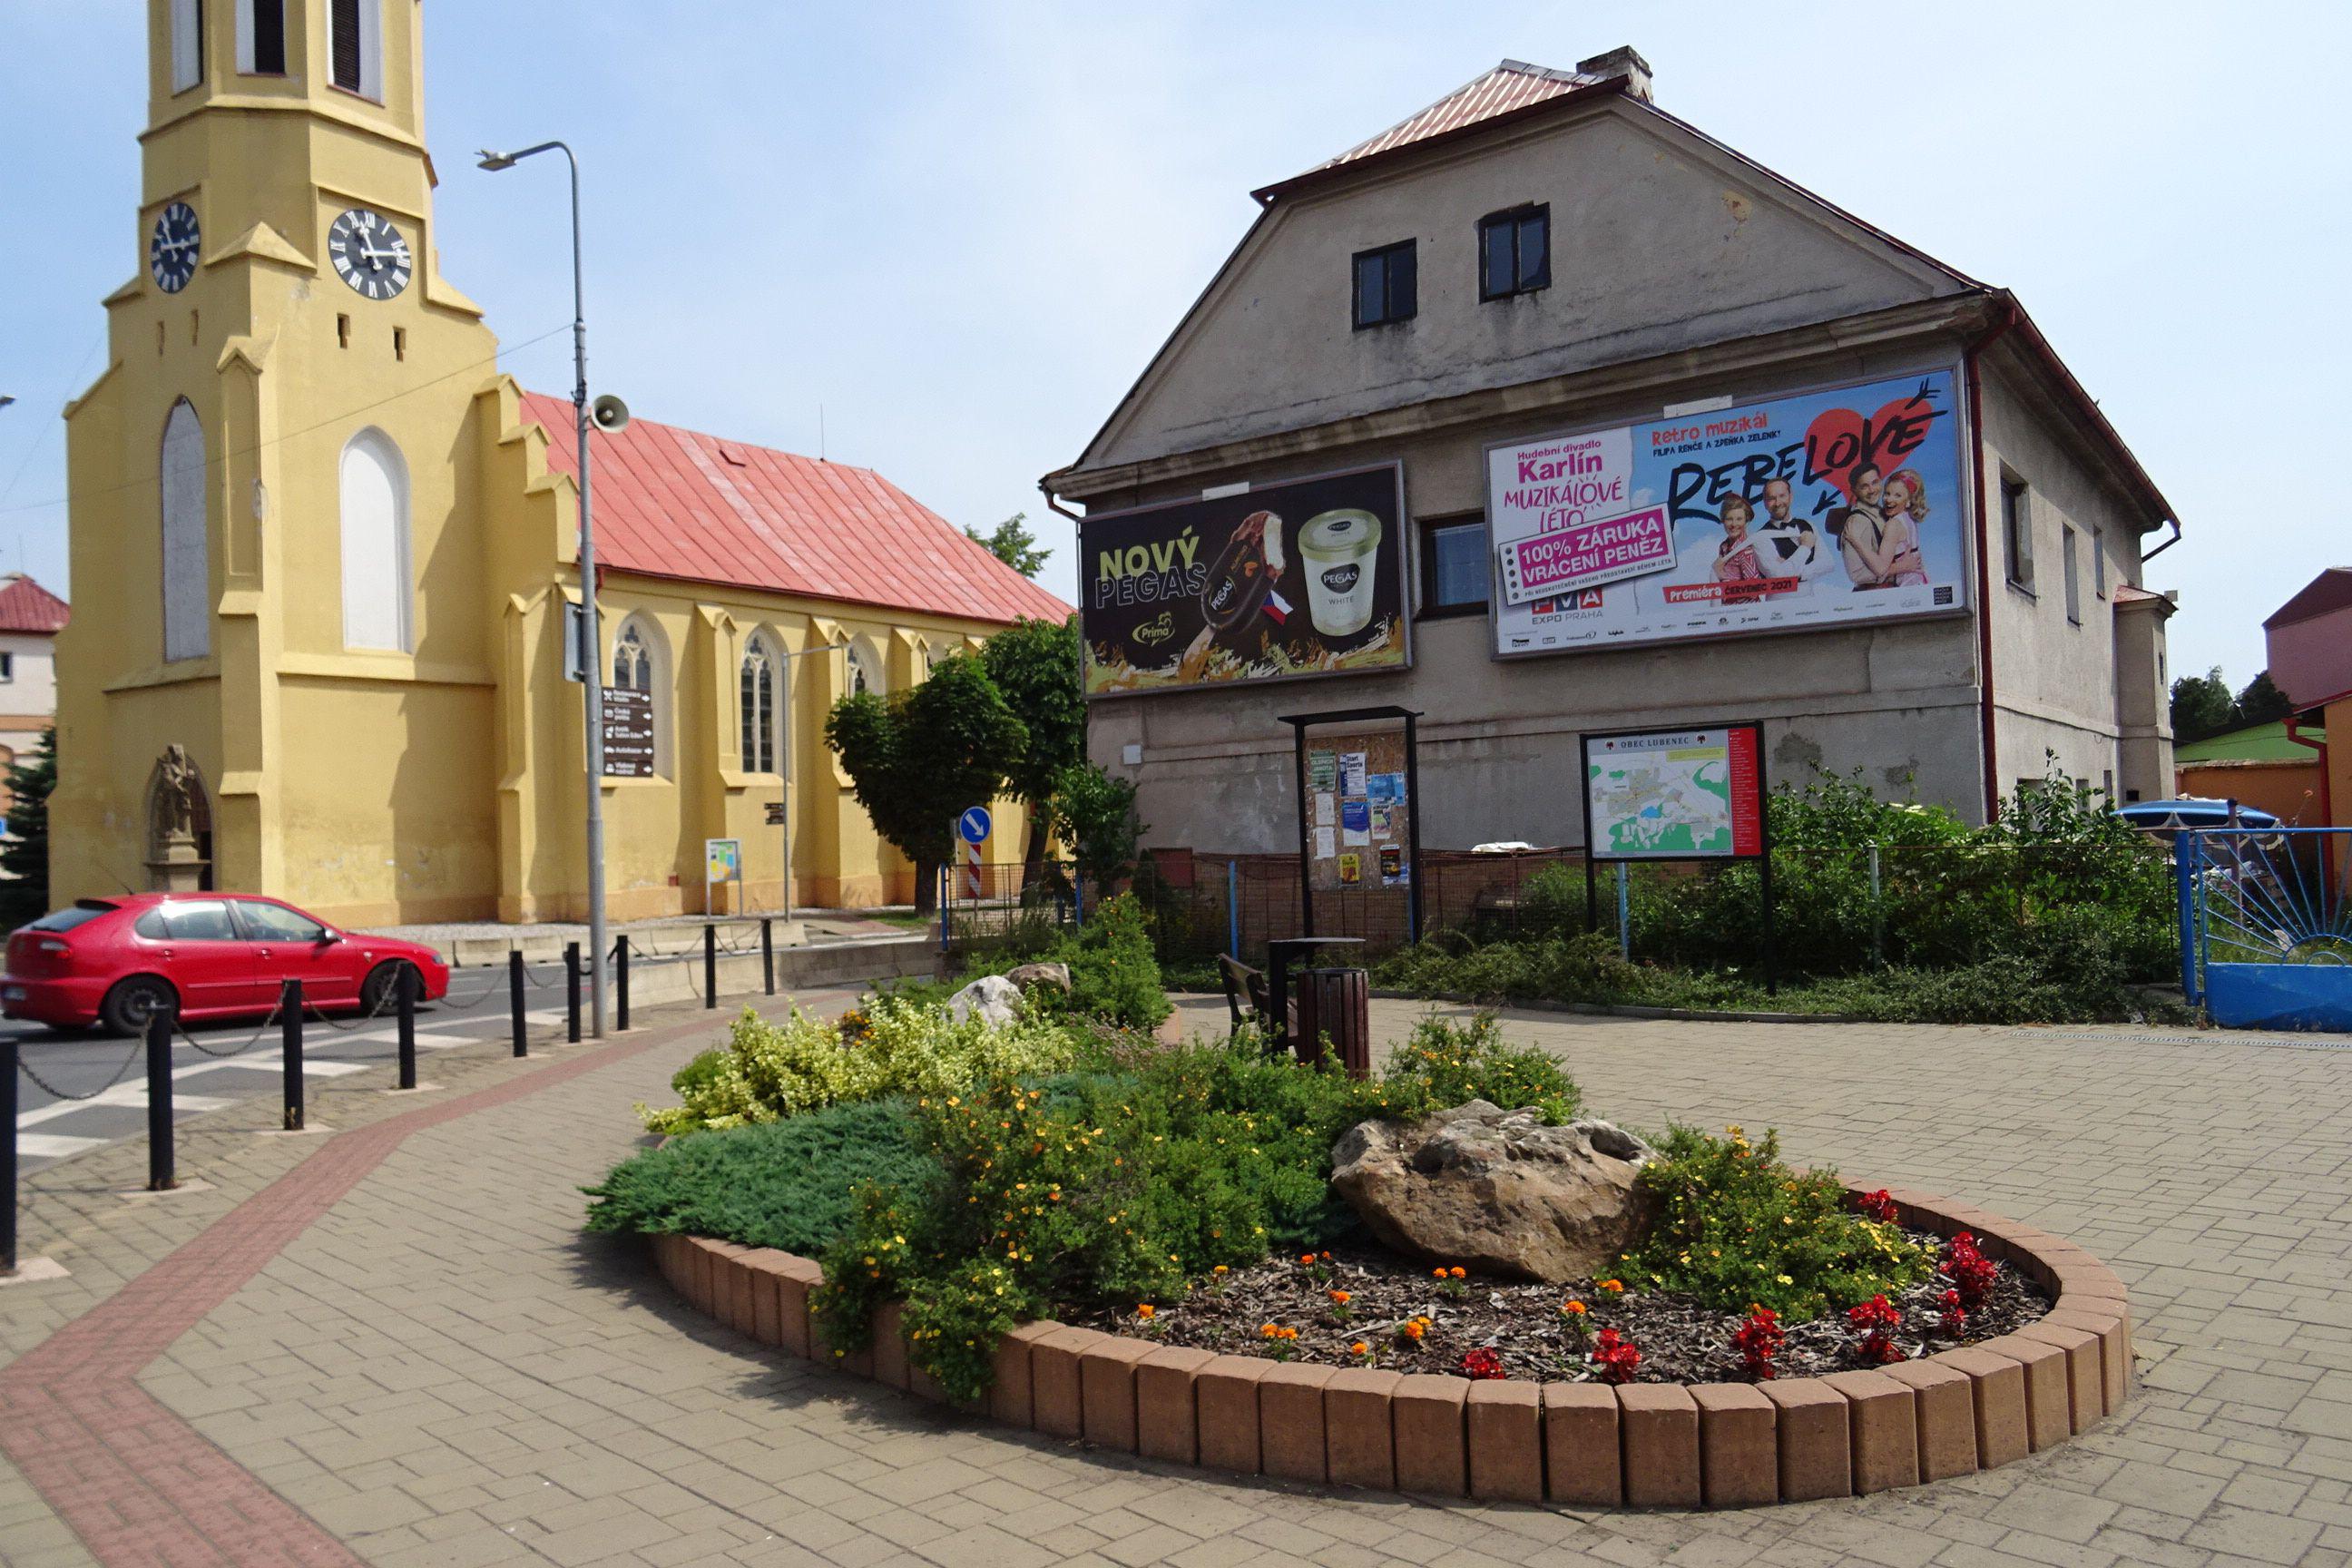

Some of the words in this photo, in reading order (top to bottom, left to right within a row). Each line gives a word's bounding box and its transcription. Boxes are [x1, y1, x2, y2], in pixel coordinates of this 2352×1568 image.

[1651, 426, 1700, 446] Retro
[1705, 411, 1768, 436] muzikál
[1517, 446, 1561, 461] Hudební
[1563, 439, 1601, 454] divadlo
[1652, 447, 1675, 457] FILIPA
[1517, 452, 1602, 484] Karlín
[1504, 475, 1623, 510] MUZIKÁLOVÉ
[1100, 524, 1200, 582] NOVÝ
[1522, 538, 1572, 564] 100%
[1577, 517, 1660, 552] ZÁRUKA
[1524, 553, 1600, 583] VRÁCENÍ
[1604, 535, 1664, 564] PENĚZ
[1095, 563, 1207, 609] PEGAS
[1323, 572, 1357, 583] PEGAS
[1670, 586, 1722, 602] Premiéra
[1725, 583, 1767, 595] ČERVENEC
[1770, 580, 1792, 591] 2021
[1210, 581, 1233, 611] PEGAS
[1328, 595, 1354, 605] WHITE
[1532, 614, 1562, 625] EXPO
[1565, 610, 1603, 622] PRAHA
[1621, 740, 1644, 749] OBEC
[1647, 736, 1689, 747] LUBENEC
